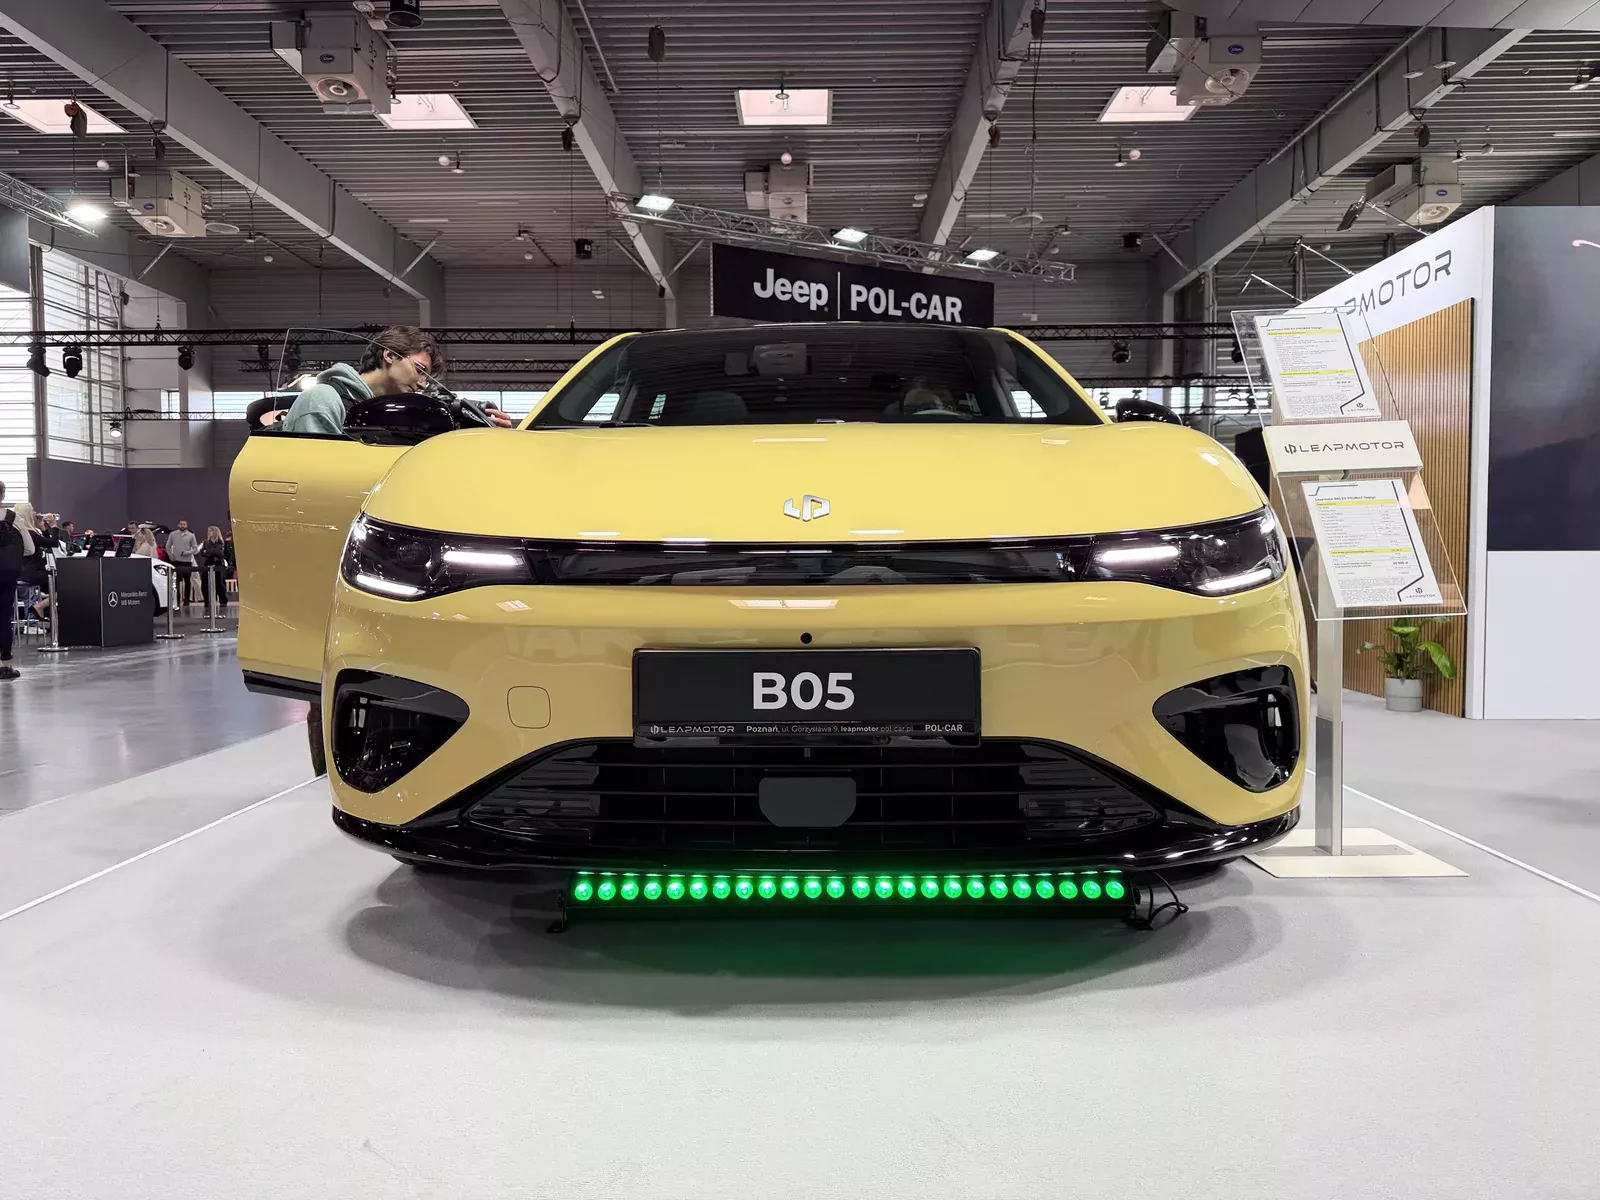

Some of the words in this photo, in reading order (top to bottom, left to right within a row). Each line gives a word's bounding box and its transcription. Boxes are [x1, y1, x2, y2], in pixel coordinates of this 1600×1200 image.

[753, 268, 829, 311] Jeep
[850, 284, 962, 323] POL-CAR
[1299, 441, 1405, 453] LEAPMOTOR
[752, 671, 855, 711] B05
[660, 725, 735, 733] LEAPMOTOR
[746, 724, 780, 734] Poznań,
[925, 724, 963, 732] POL-CAR
